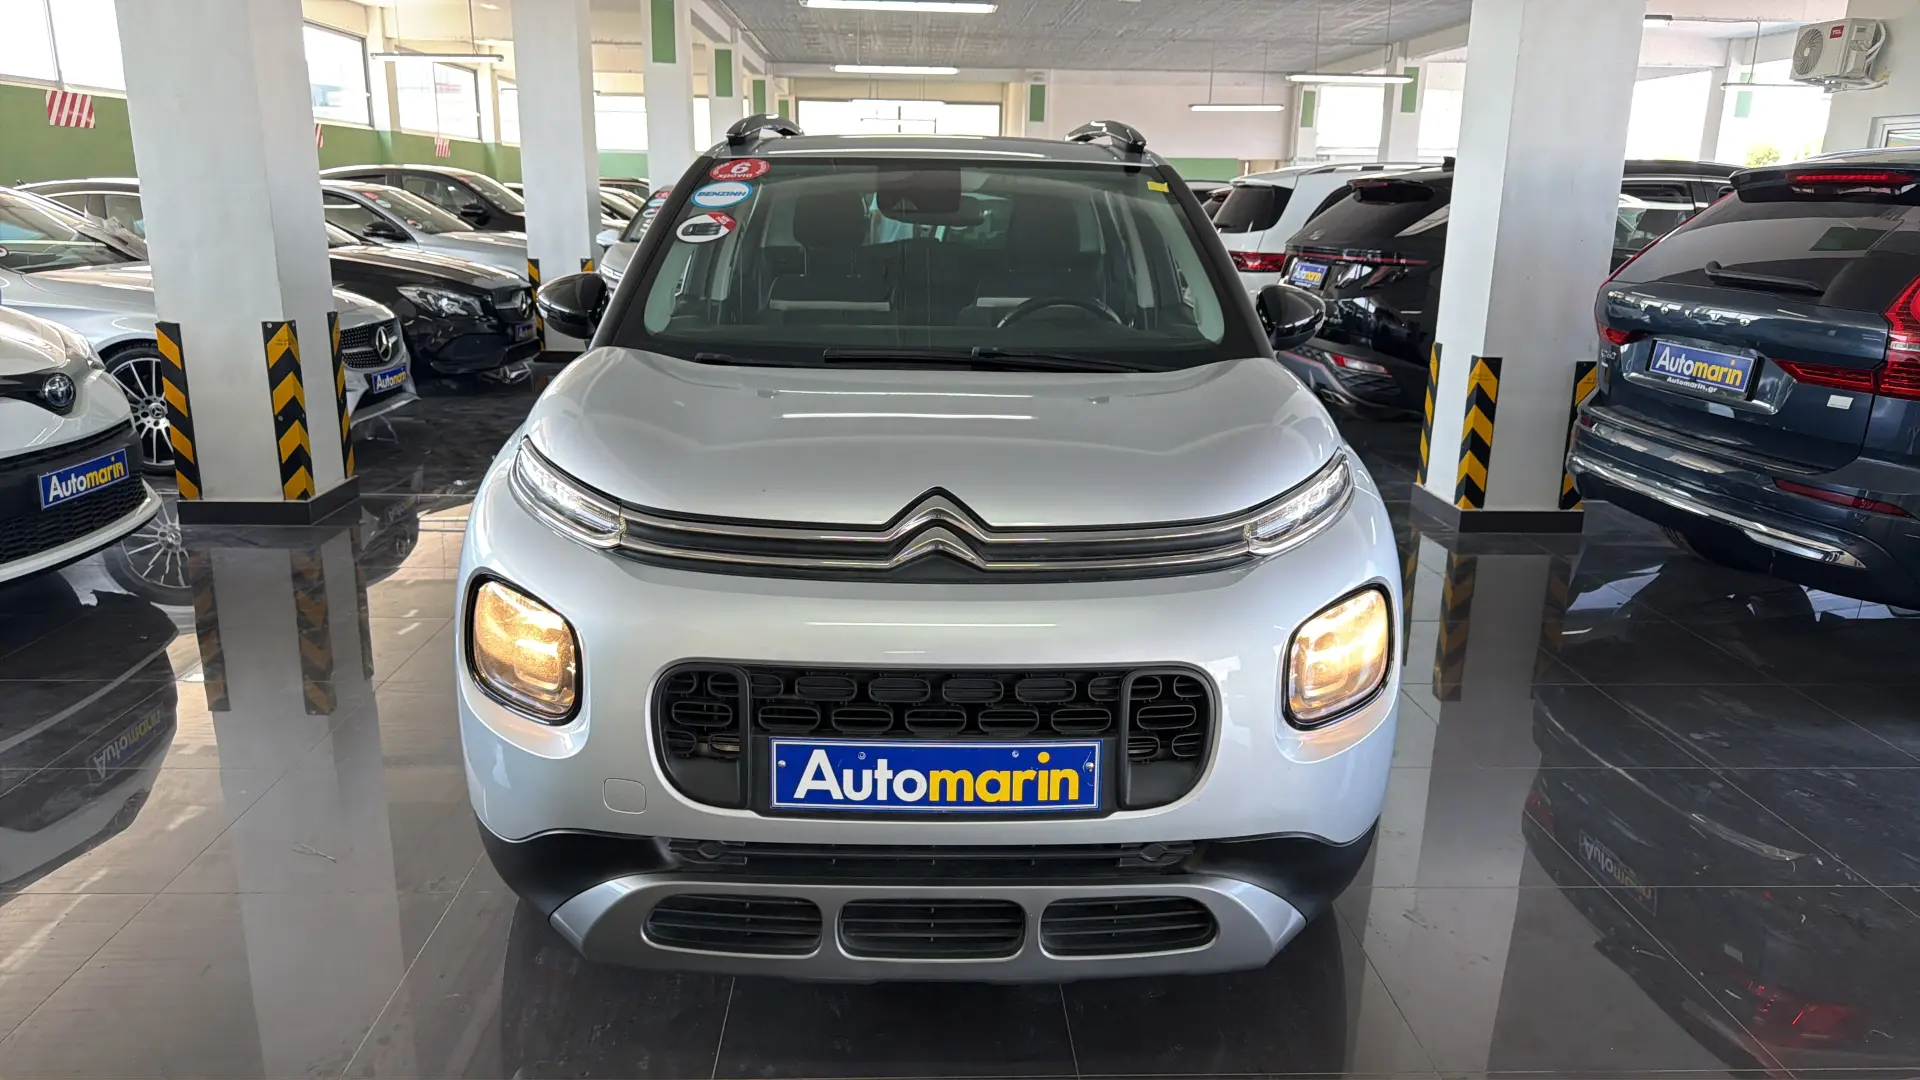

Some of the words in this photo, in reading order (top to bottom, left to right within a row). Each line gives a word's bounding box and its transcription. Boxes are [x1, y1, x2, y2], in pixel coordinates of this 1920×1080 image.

[731, 162, 751, 173] 6
[1655, 347, 1743, 386] Automarin
[1666, 376, 1718, 393] Automarin.gr
[48, 455, 125, 502] Automarin
[793, 749, 1080, 802] Automarin
